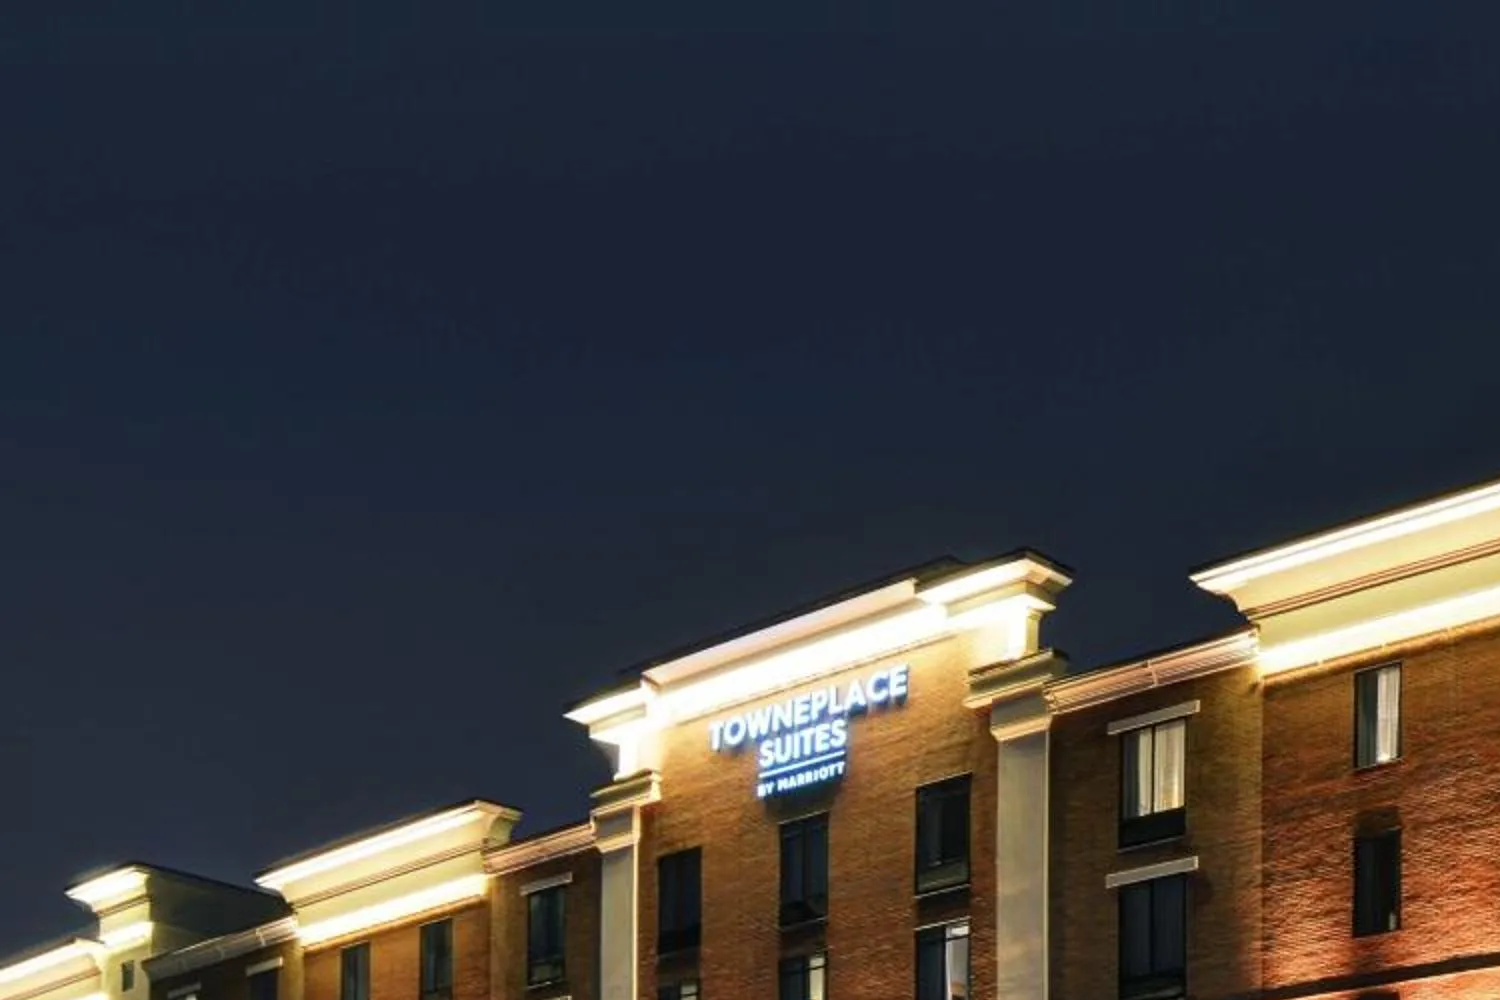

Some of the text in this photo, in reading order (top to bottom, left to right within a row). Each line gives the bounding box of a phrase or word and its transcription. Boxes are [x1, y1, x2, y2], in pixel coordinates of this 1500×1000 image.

[709, 663, 909, 752] TOWNEPLACE
[758, 718, 848, 769] SUITES
[757, 760, 846, 797] BY MARRIOTT
